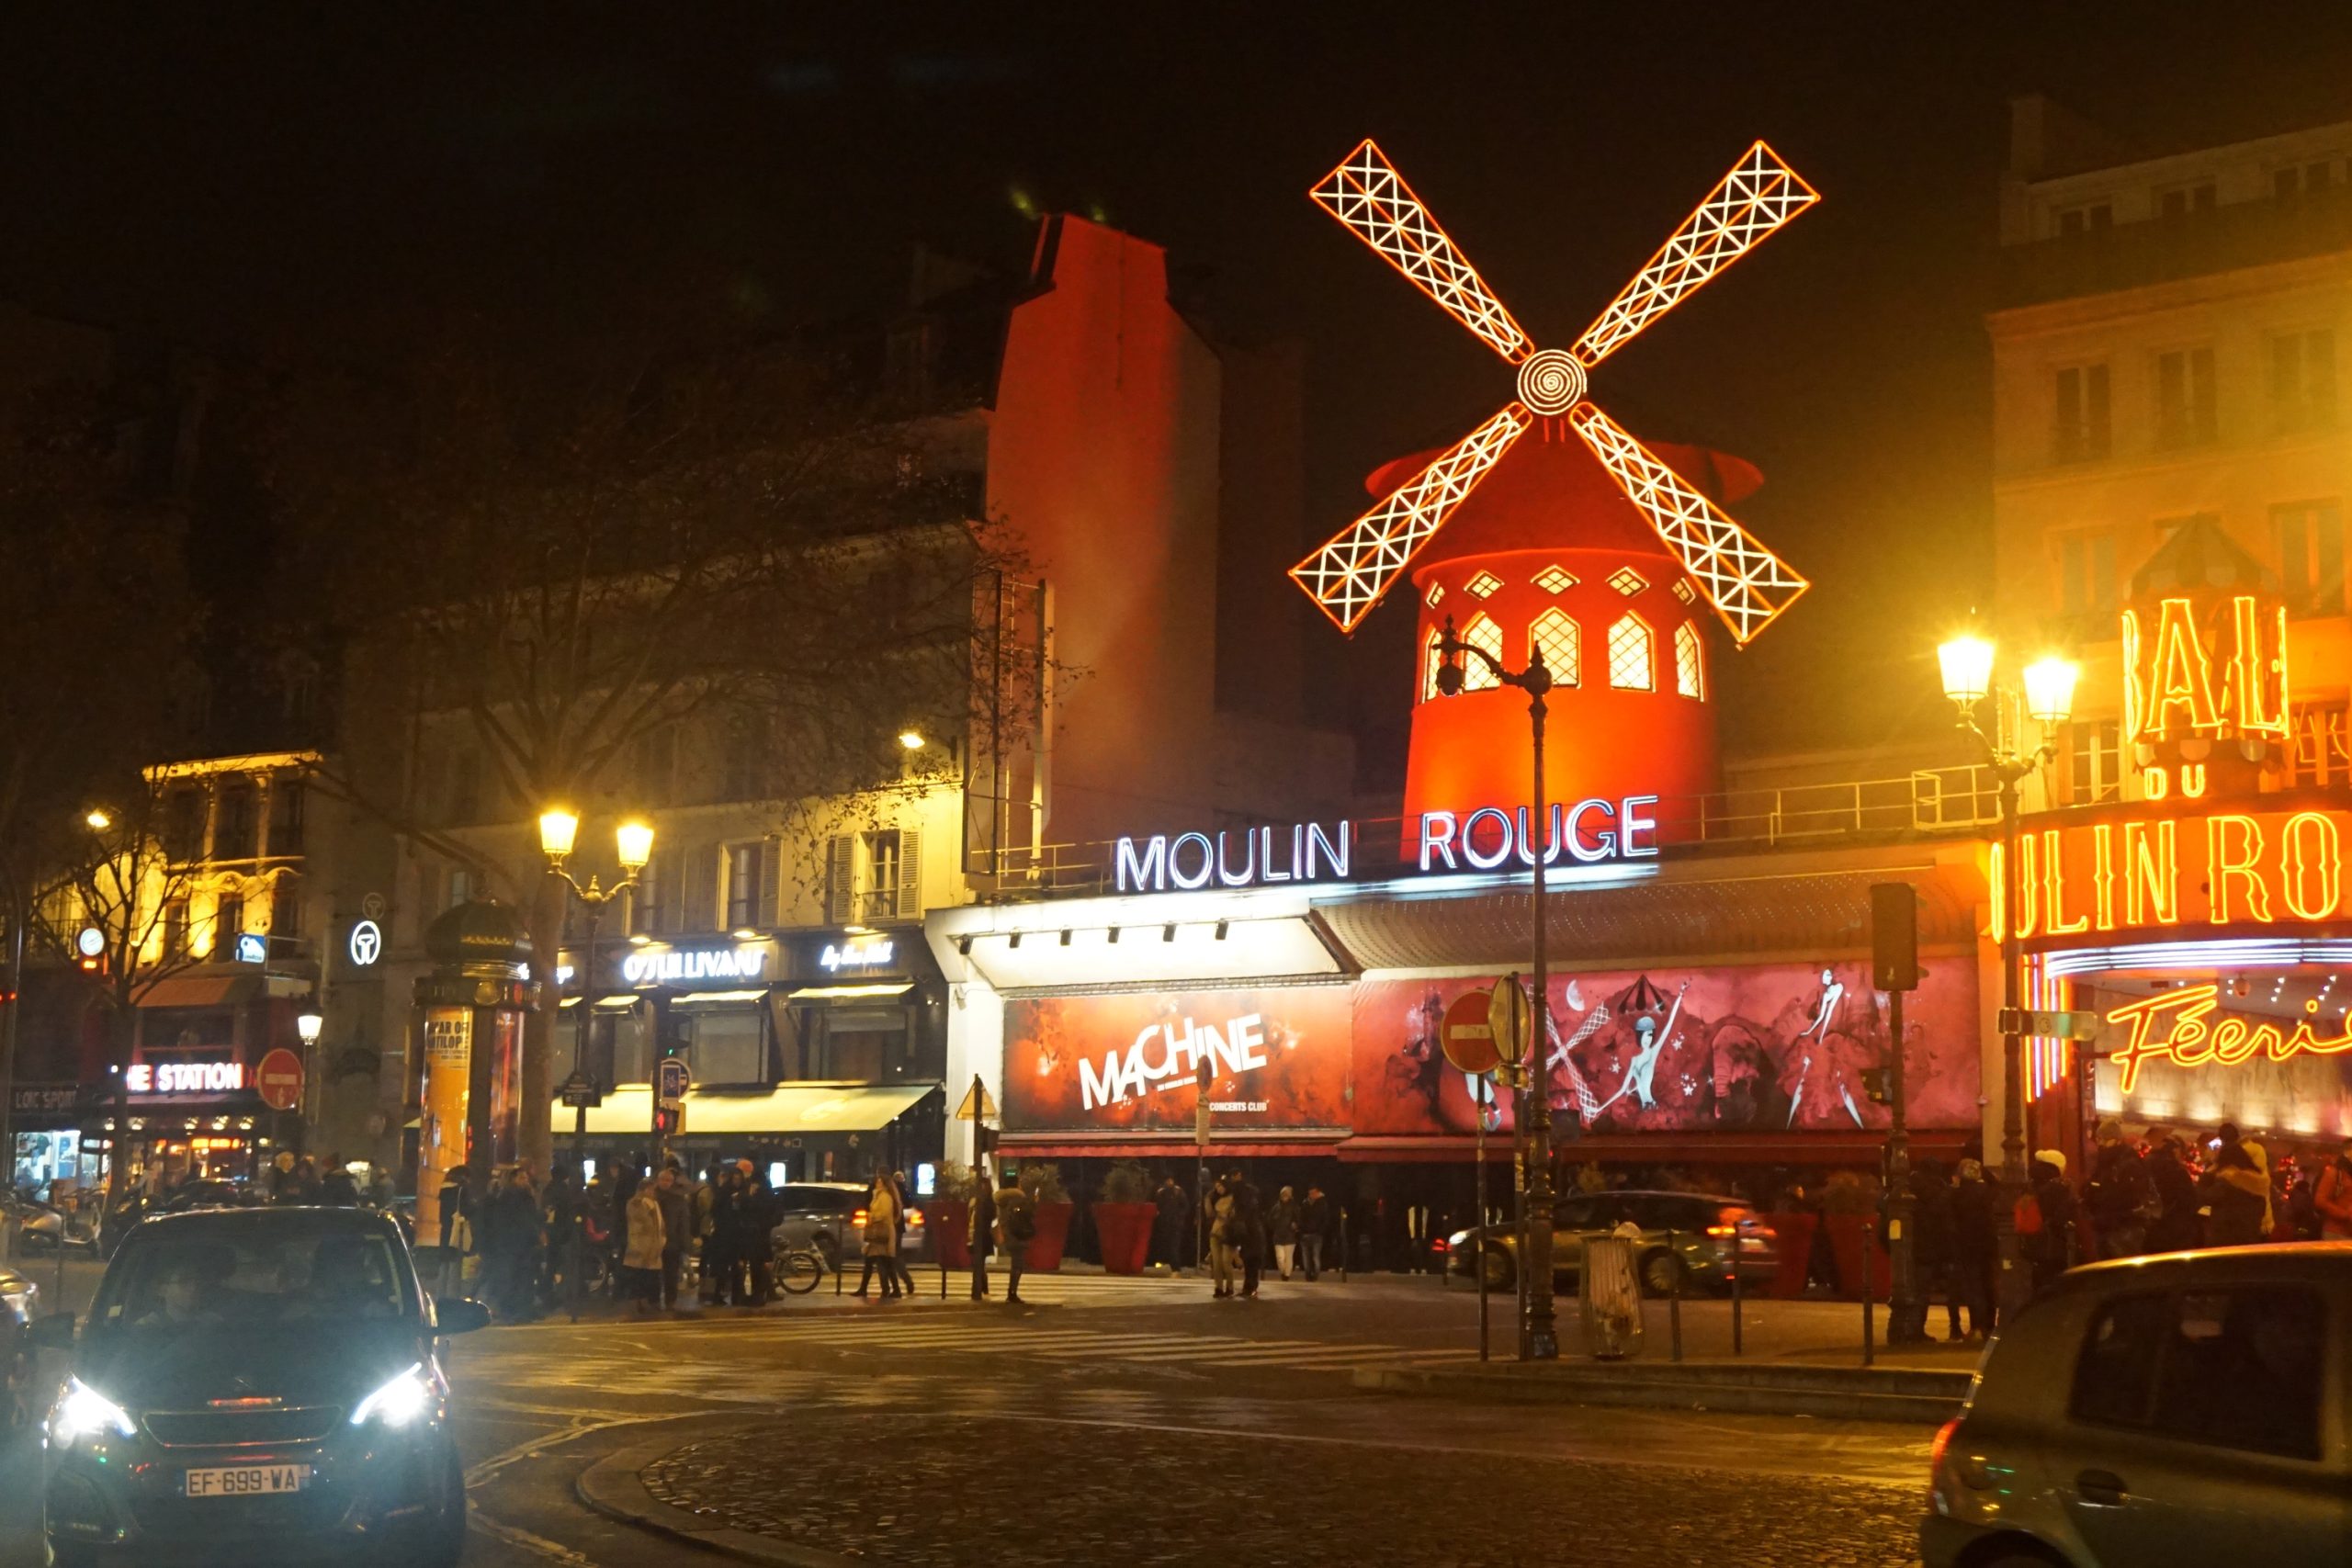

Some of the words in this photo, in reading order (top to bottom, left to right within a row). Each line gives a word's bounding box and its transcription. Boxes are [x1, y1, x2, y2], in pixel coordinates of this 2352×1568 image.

[2143, 764, 2206, 800] DU
[1115, 821, 1349, 891] MOULIN
[1420, 795, 1659, 871] ROUGE
[158, 1063, 243, 1091] STATION
[1079, 1013, 1267, 1111] MACHINE
[1209, 1101, 1247, 1111] CONCERTS
[1248, 1101, 1268, 1111] CLUB
[188, 1469, 296, 1495] EF-699-WA
